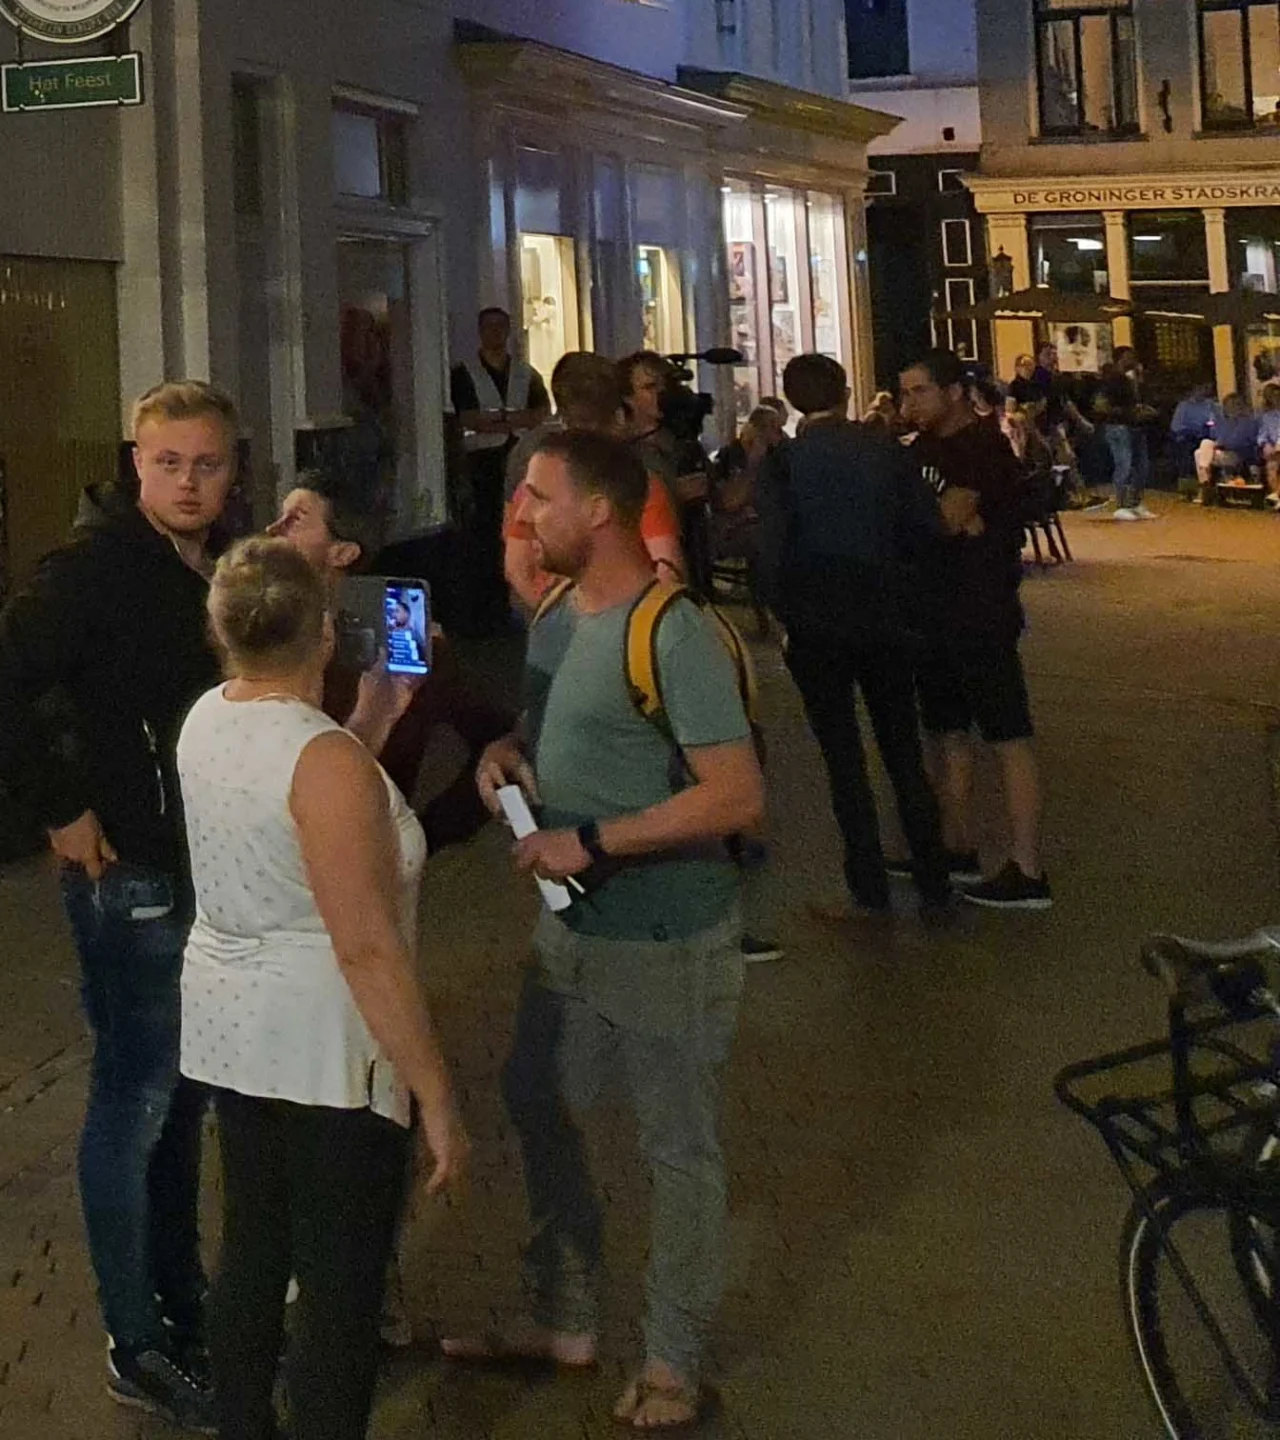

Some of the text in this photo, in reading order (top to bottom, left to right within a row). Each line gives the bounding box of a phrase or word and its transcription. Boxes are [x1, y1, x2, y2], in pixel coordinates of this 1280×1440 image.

[64, 71, 112, 90] Feest
[1012, 191, 1040, 205] DE
[1043, 187, 1165, 204] GRONINGER
